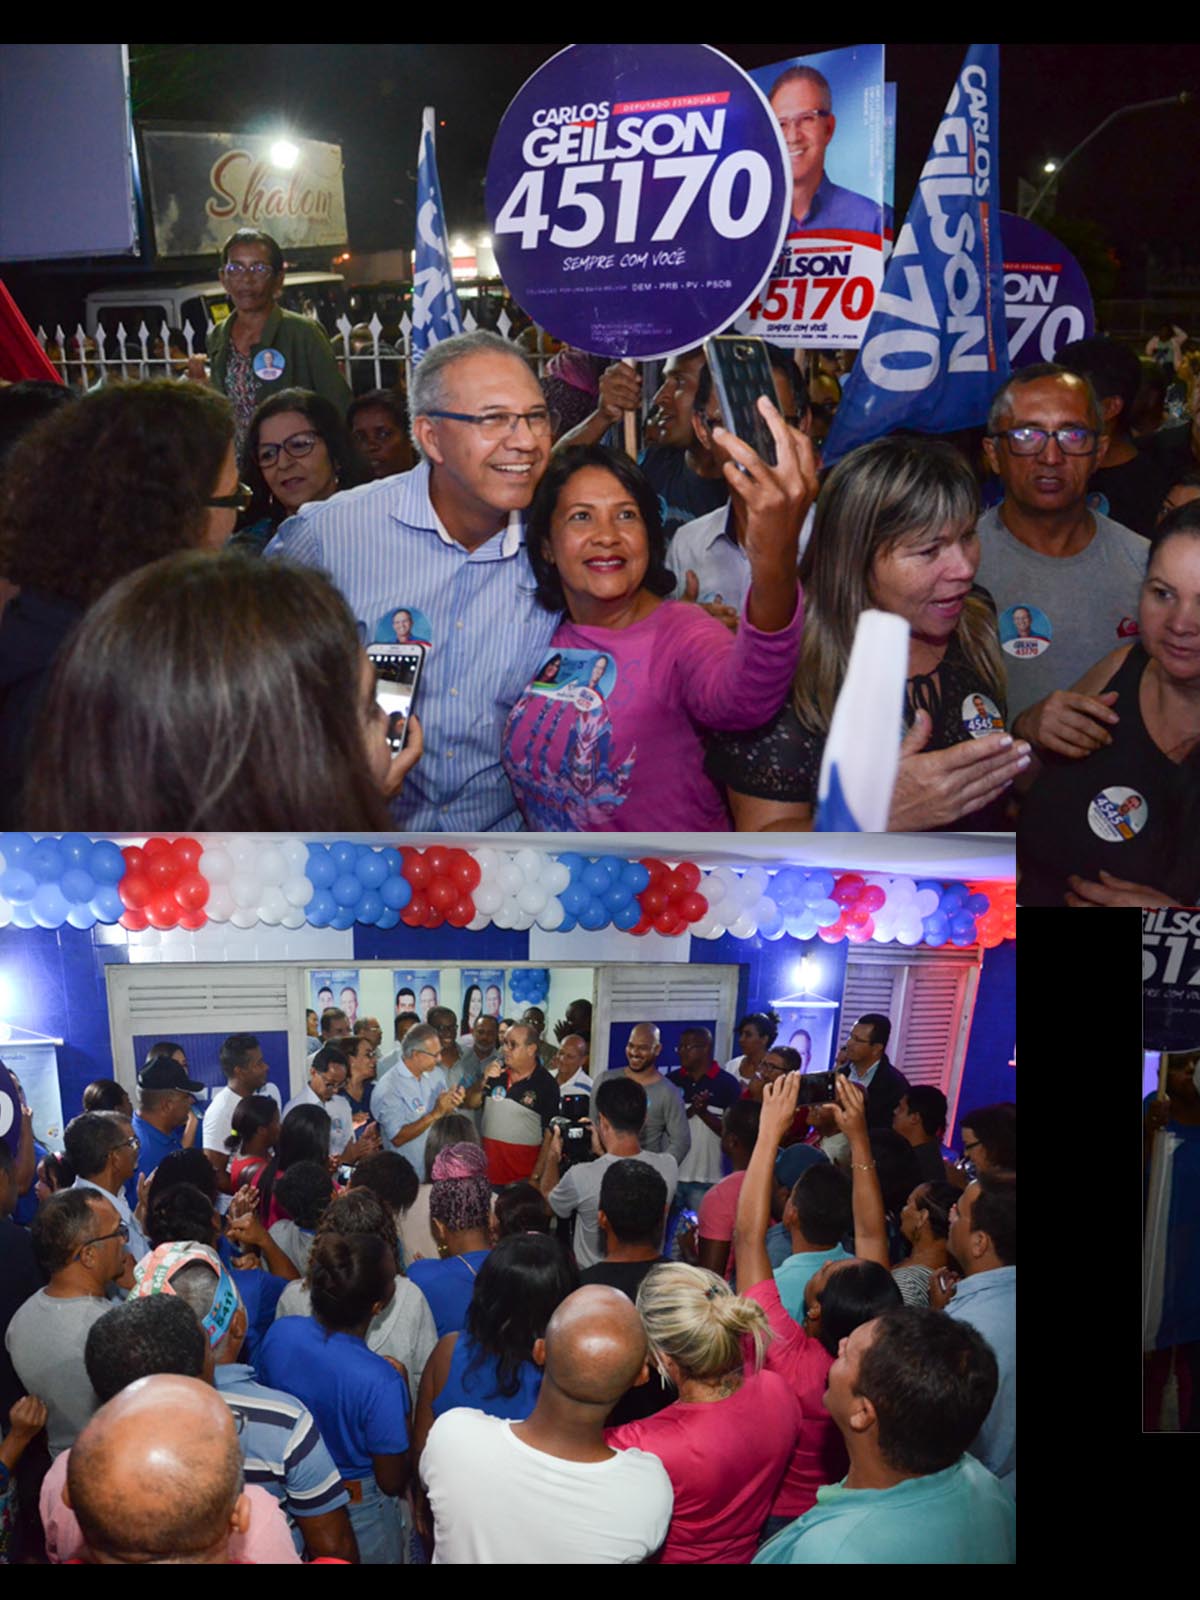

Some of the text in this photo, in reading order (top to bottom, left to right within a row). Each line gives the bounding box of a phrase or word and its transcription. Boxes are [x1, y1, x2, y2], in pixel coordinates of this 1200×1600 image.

[532, 101, 610, 127] CARLOS
[961, 64, 990, 197] CARLOS
[522, 109, 726, 167] GEILSON
[206, 150, 332, 222] Shalom
[494, 150, 772, 249] 45170
[562, 254, 614, 271] SEMPRE
[619, 252, 648, 269] COM
[632, 282, 652, 291] DEM
[686, 280, 698, 289] PV
[968, 719, 993, 730] 4545
